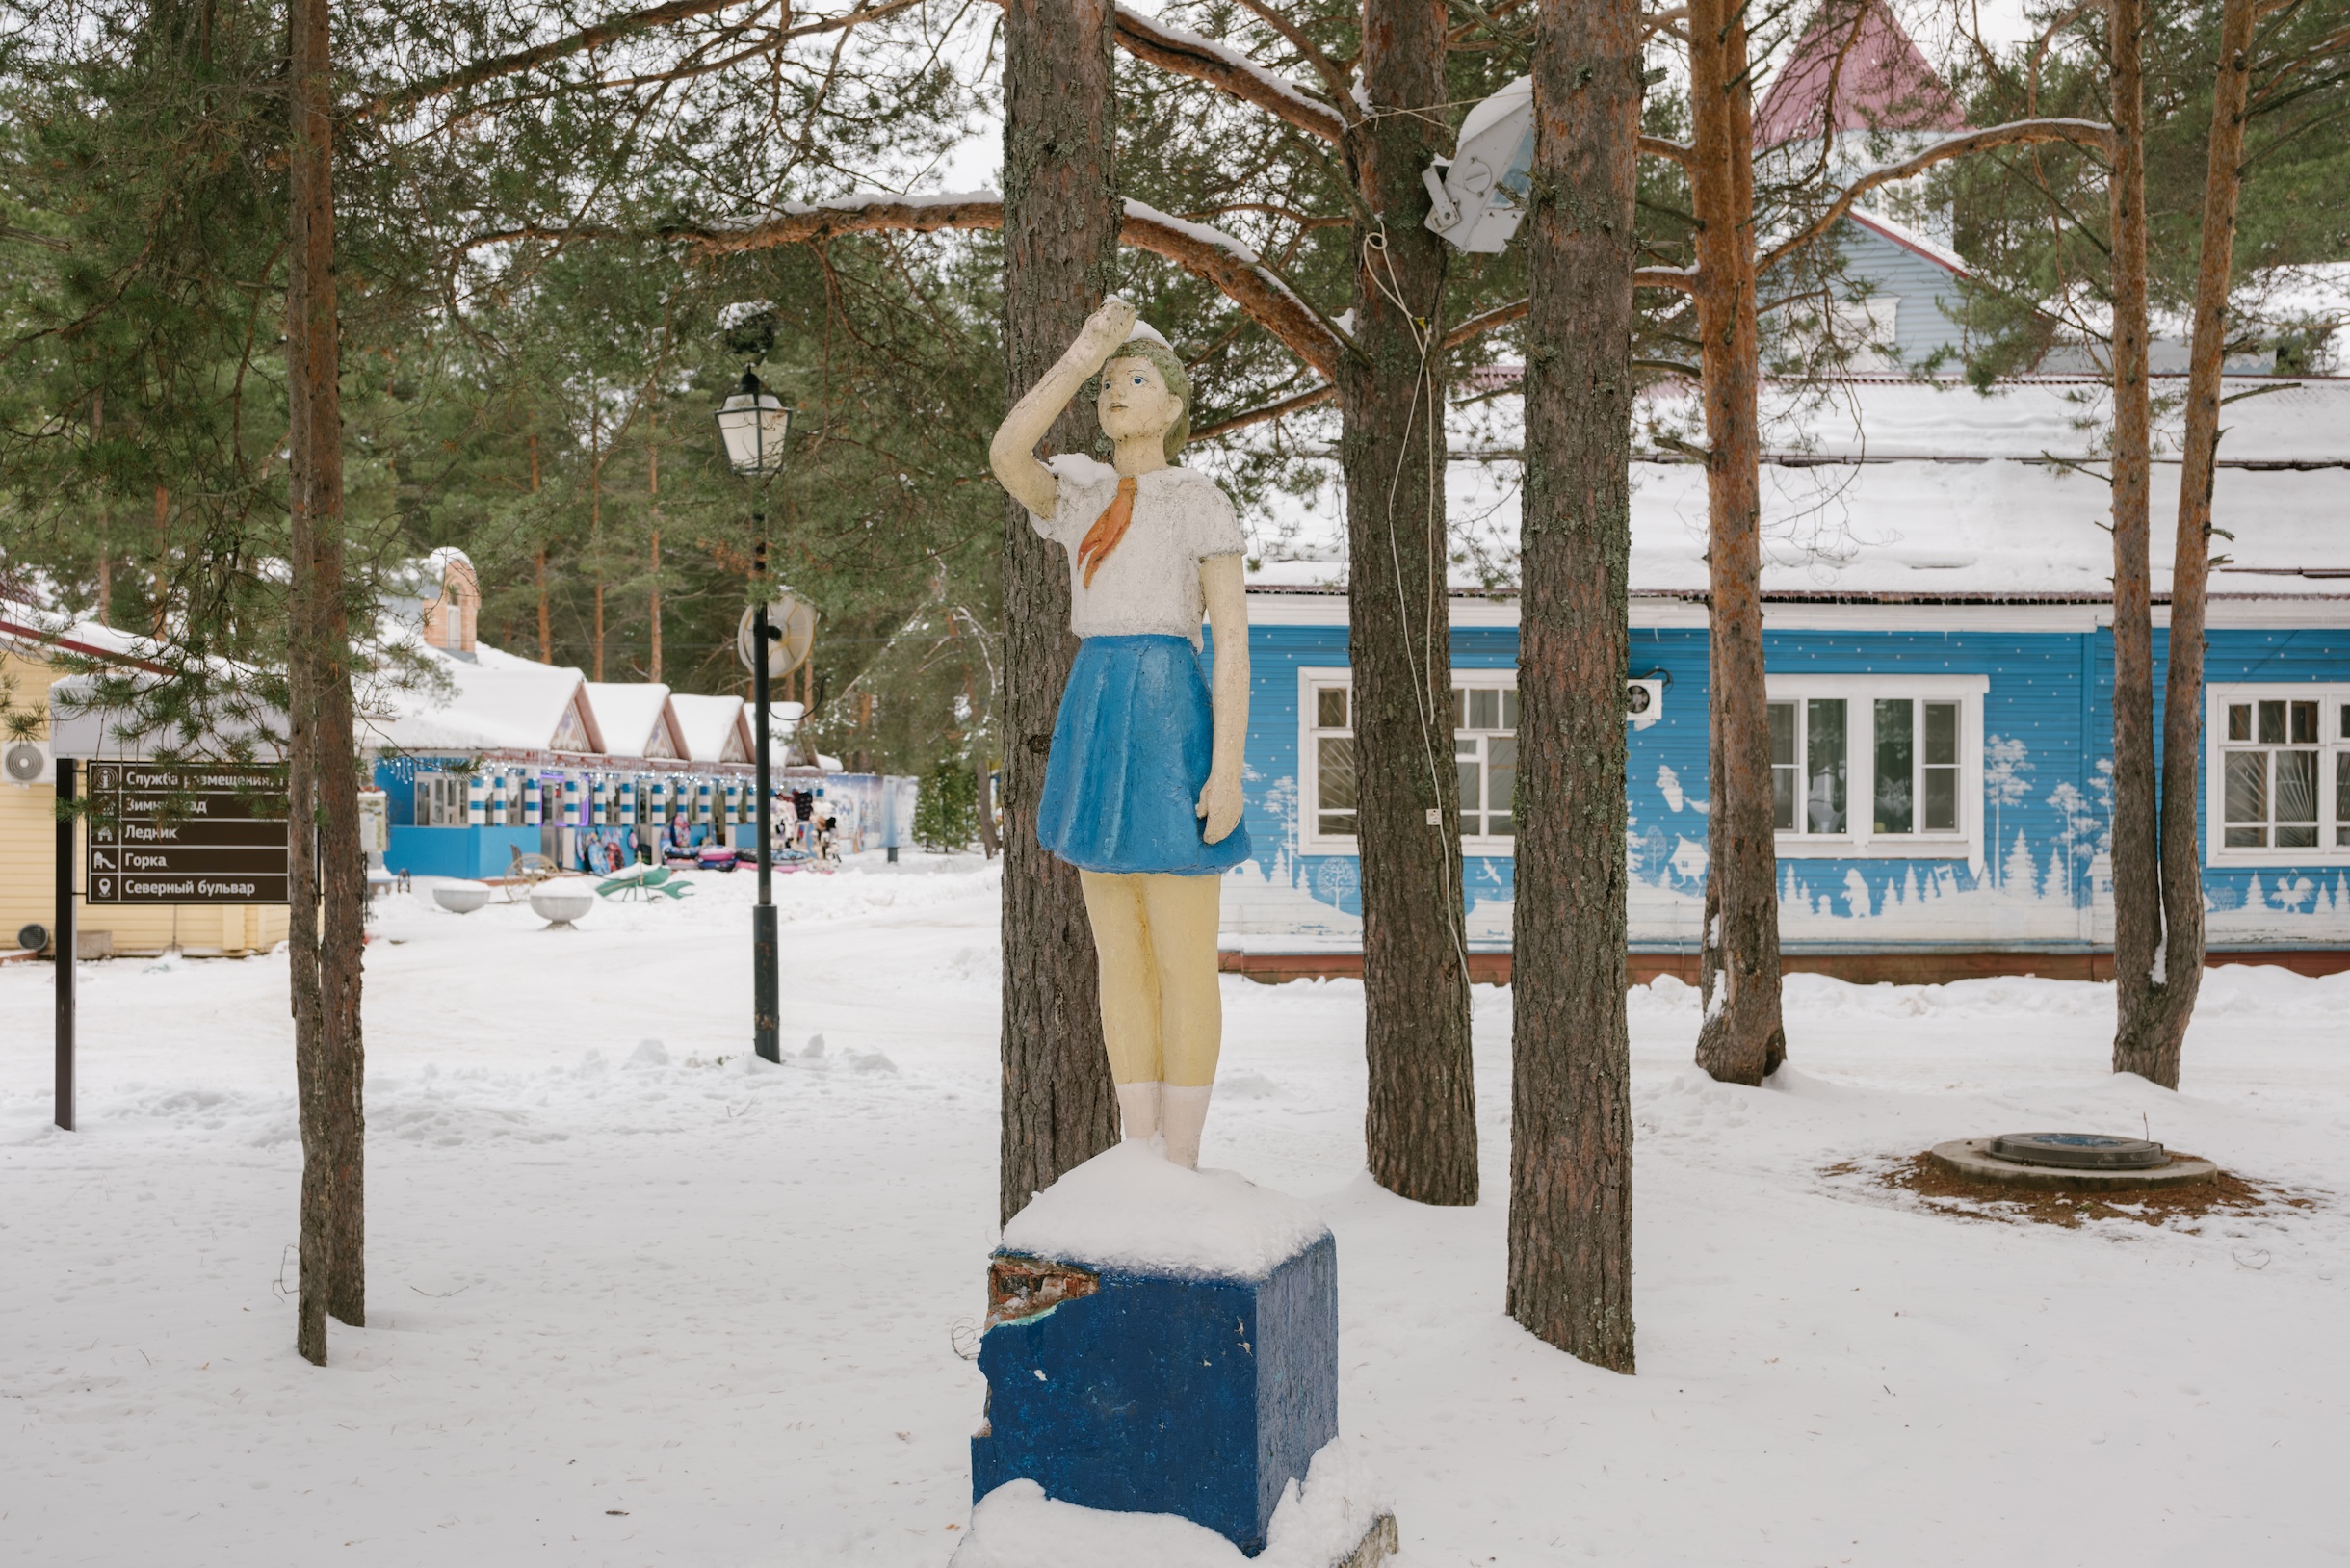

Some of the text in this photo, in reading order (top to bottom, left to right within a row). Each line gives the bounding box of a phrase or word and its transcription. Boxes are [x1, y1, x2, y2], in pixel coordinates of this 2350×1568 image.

[126, 771, 178, 788] Служба
[126, 797, 207, 814] Зимн ад
[124, 824, 177, 841] Ледник
[125, 852, 167, 870] Горка
[125, 879, 256, 897] Северный бульвар
